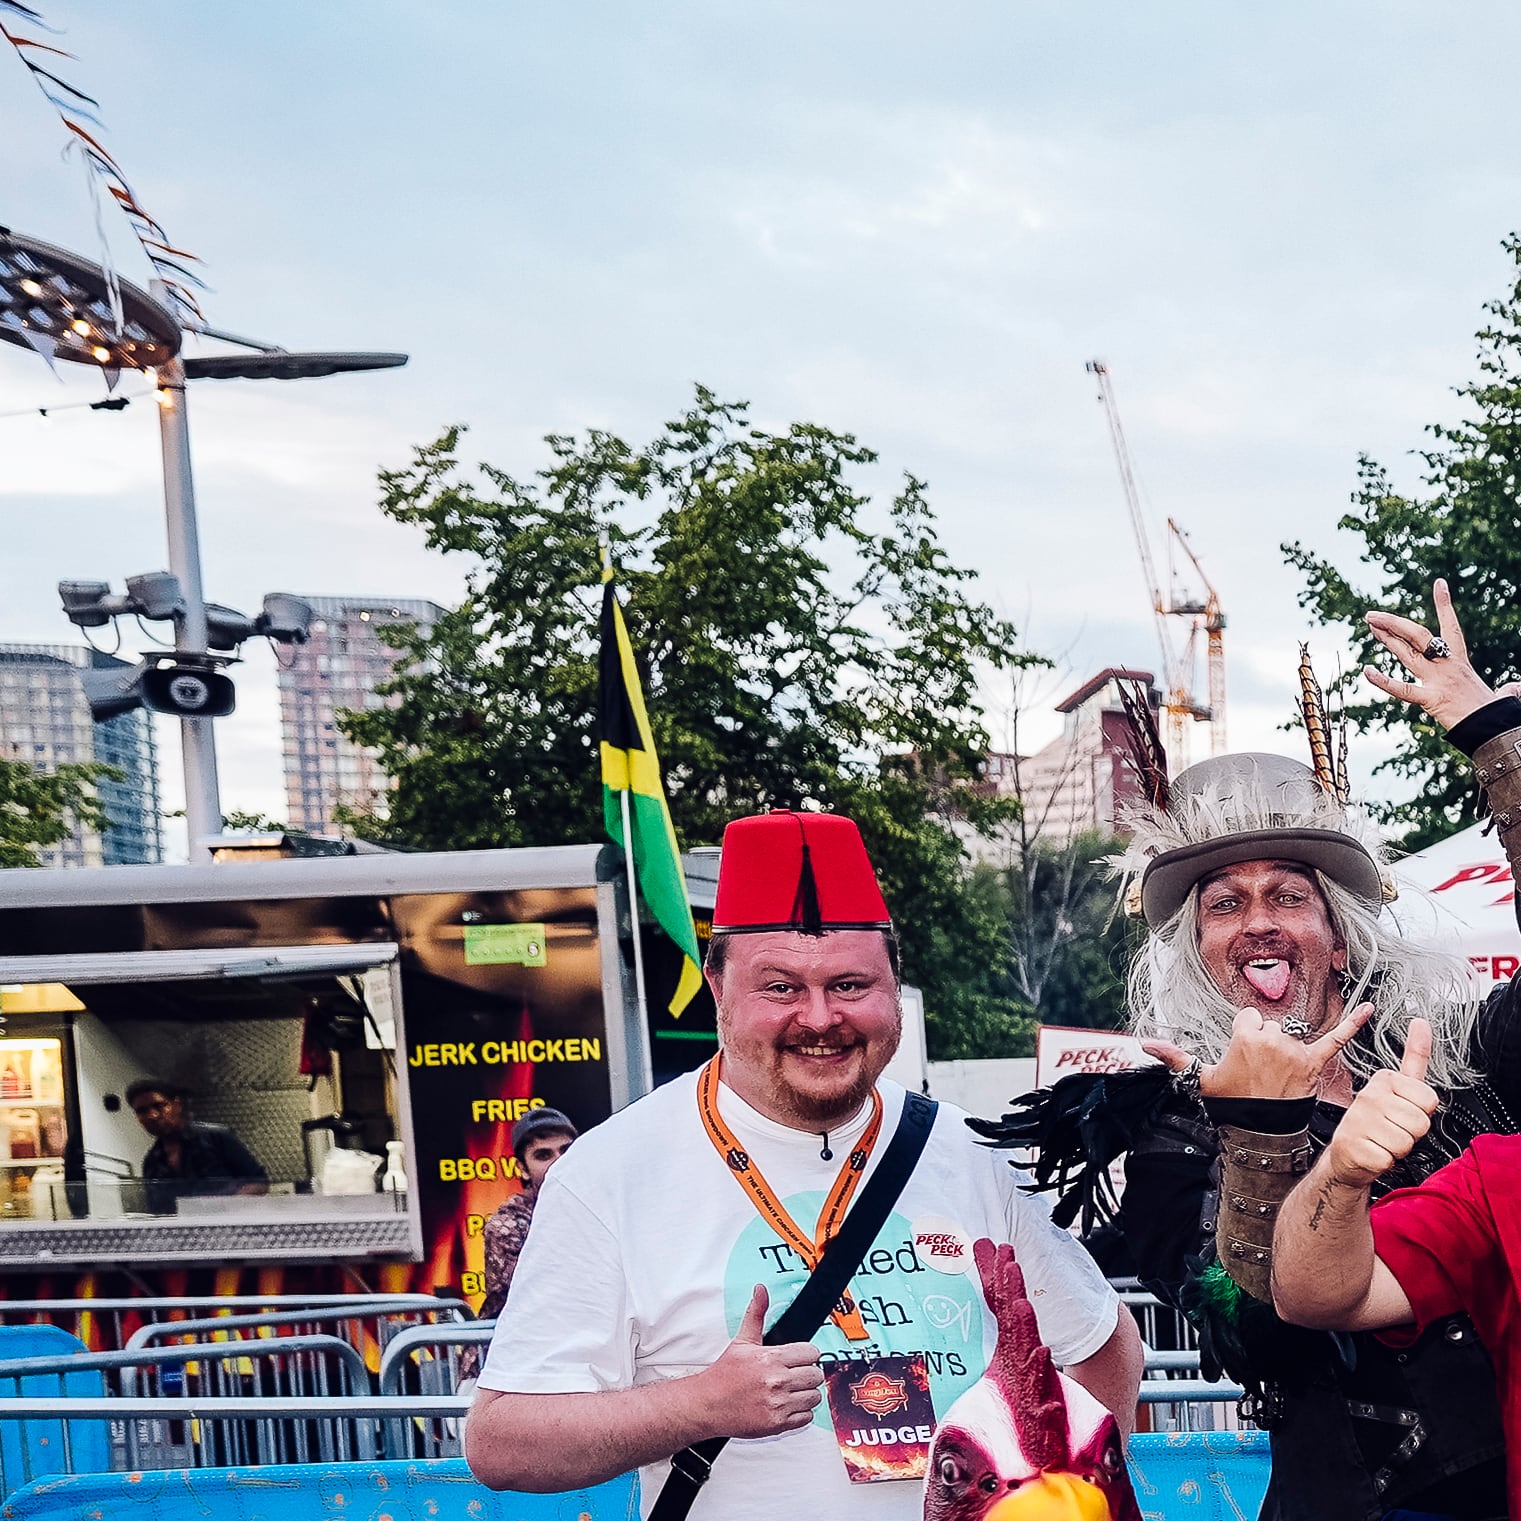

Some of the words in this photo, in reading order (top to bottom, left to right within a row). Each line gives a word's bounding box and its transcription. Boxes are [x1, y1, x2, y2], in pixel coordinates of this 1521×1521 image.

[410, 1042, 477, 1067] JERK
[481, 1037, 601, 1064] CHICKEN
[1056, 1049, 1111, 1068] PECK
[439, 1157, 496, 1182] BBQ
[746, 1175, 758, 1189] THE
[755, 1188, 779, 1218] ULTIMATE
[776, 1217, 800, 1243] CHICKEN
[916, 1234, 950, 1247] PECK
[930, 1242, 965, 1256] PECK
[845, 1425, 934, 1448] JUDGE
